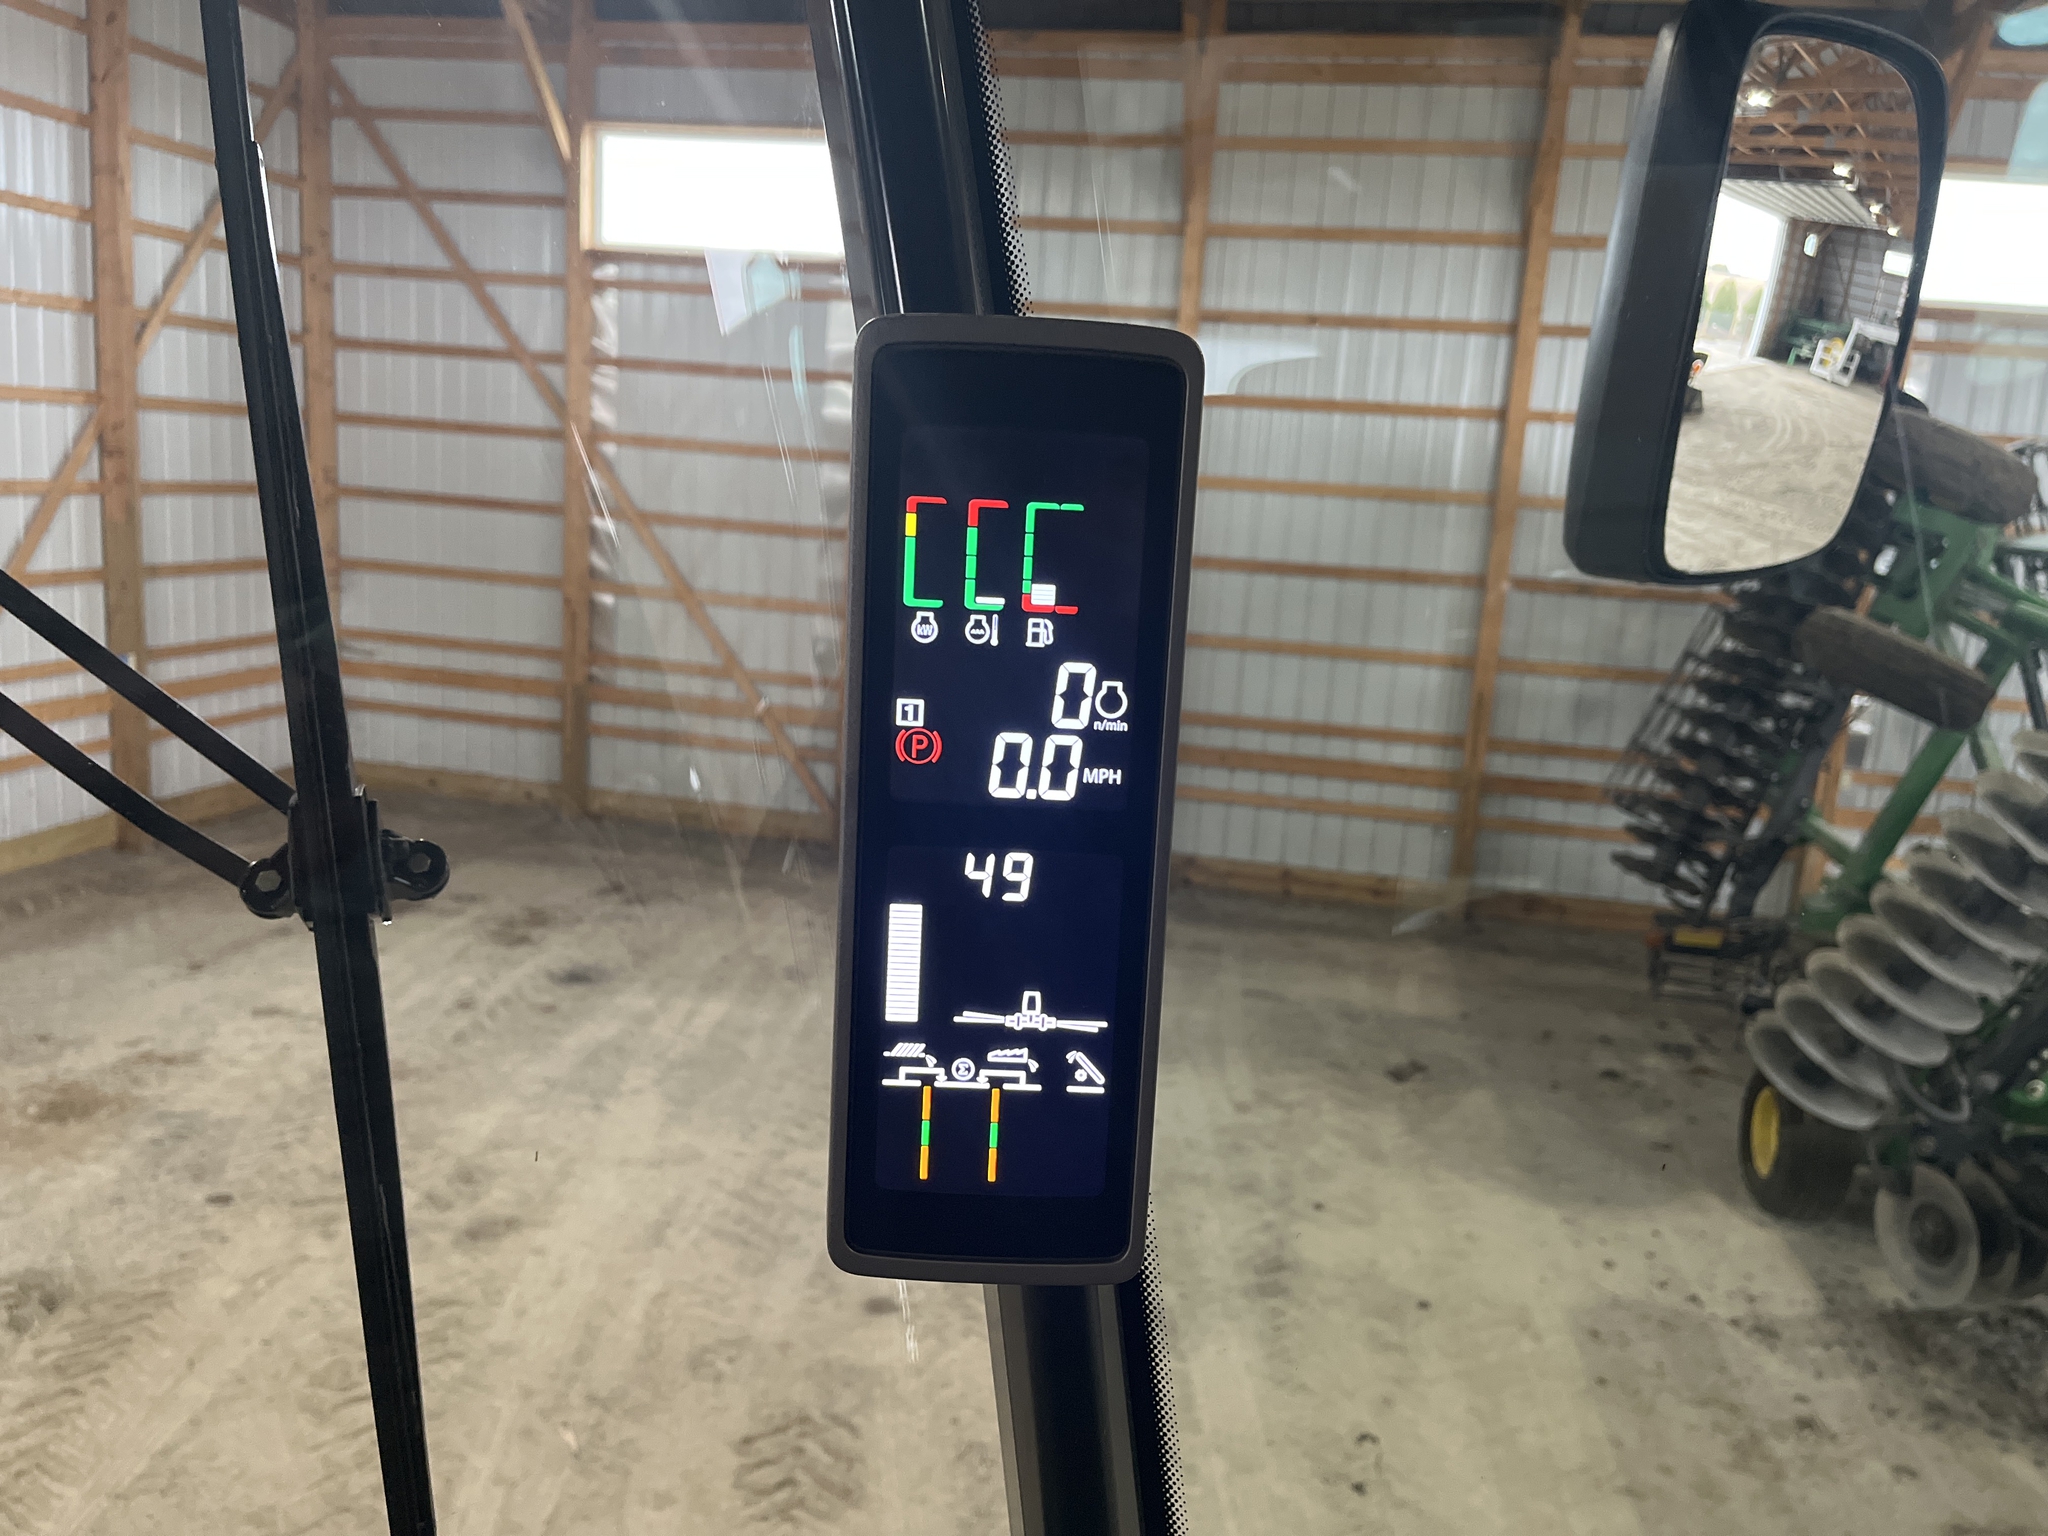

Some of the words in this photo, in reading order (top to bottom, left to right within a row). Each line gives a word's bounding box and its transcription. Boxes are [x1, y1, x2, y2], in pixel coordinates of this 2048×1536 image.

[1051, 661, 1097, 730] 0
[1093, 720, 1129, 733] n/min
[911, 734, 929, 759] P
[988, 732, 1084, 801] 0.0
[1082, 767, 1122, 785] MPH
[964, 852, 1034, 902] 49
